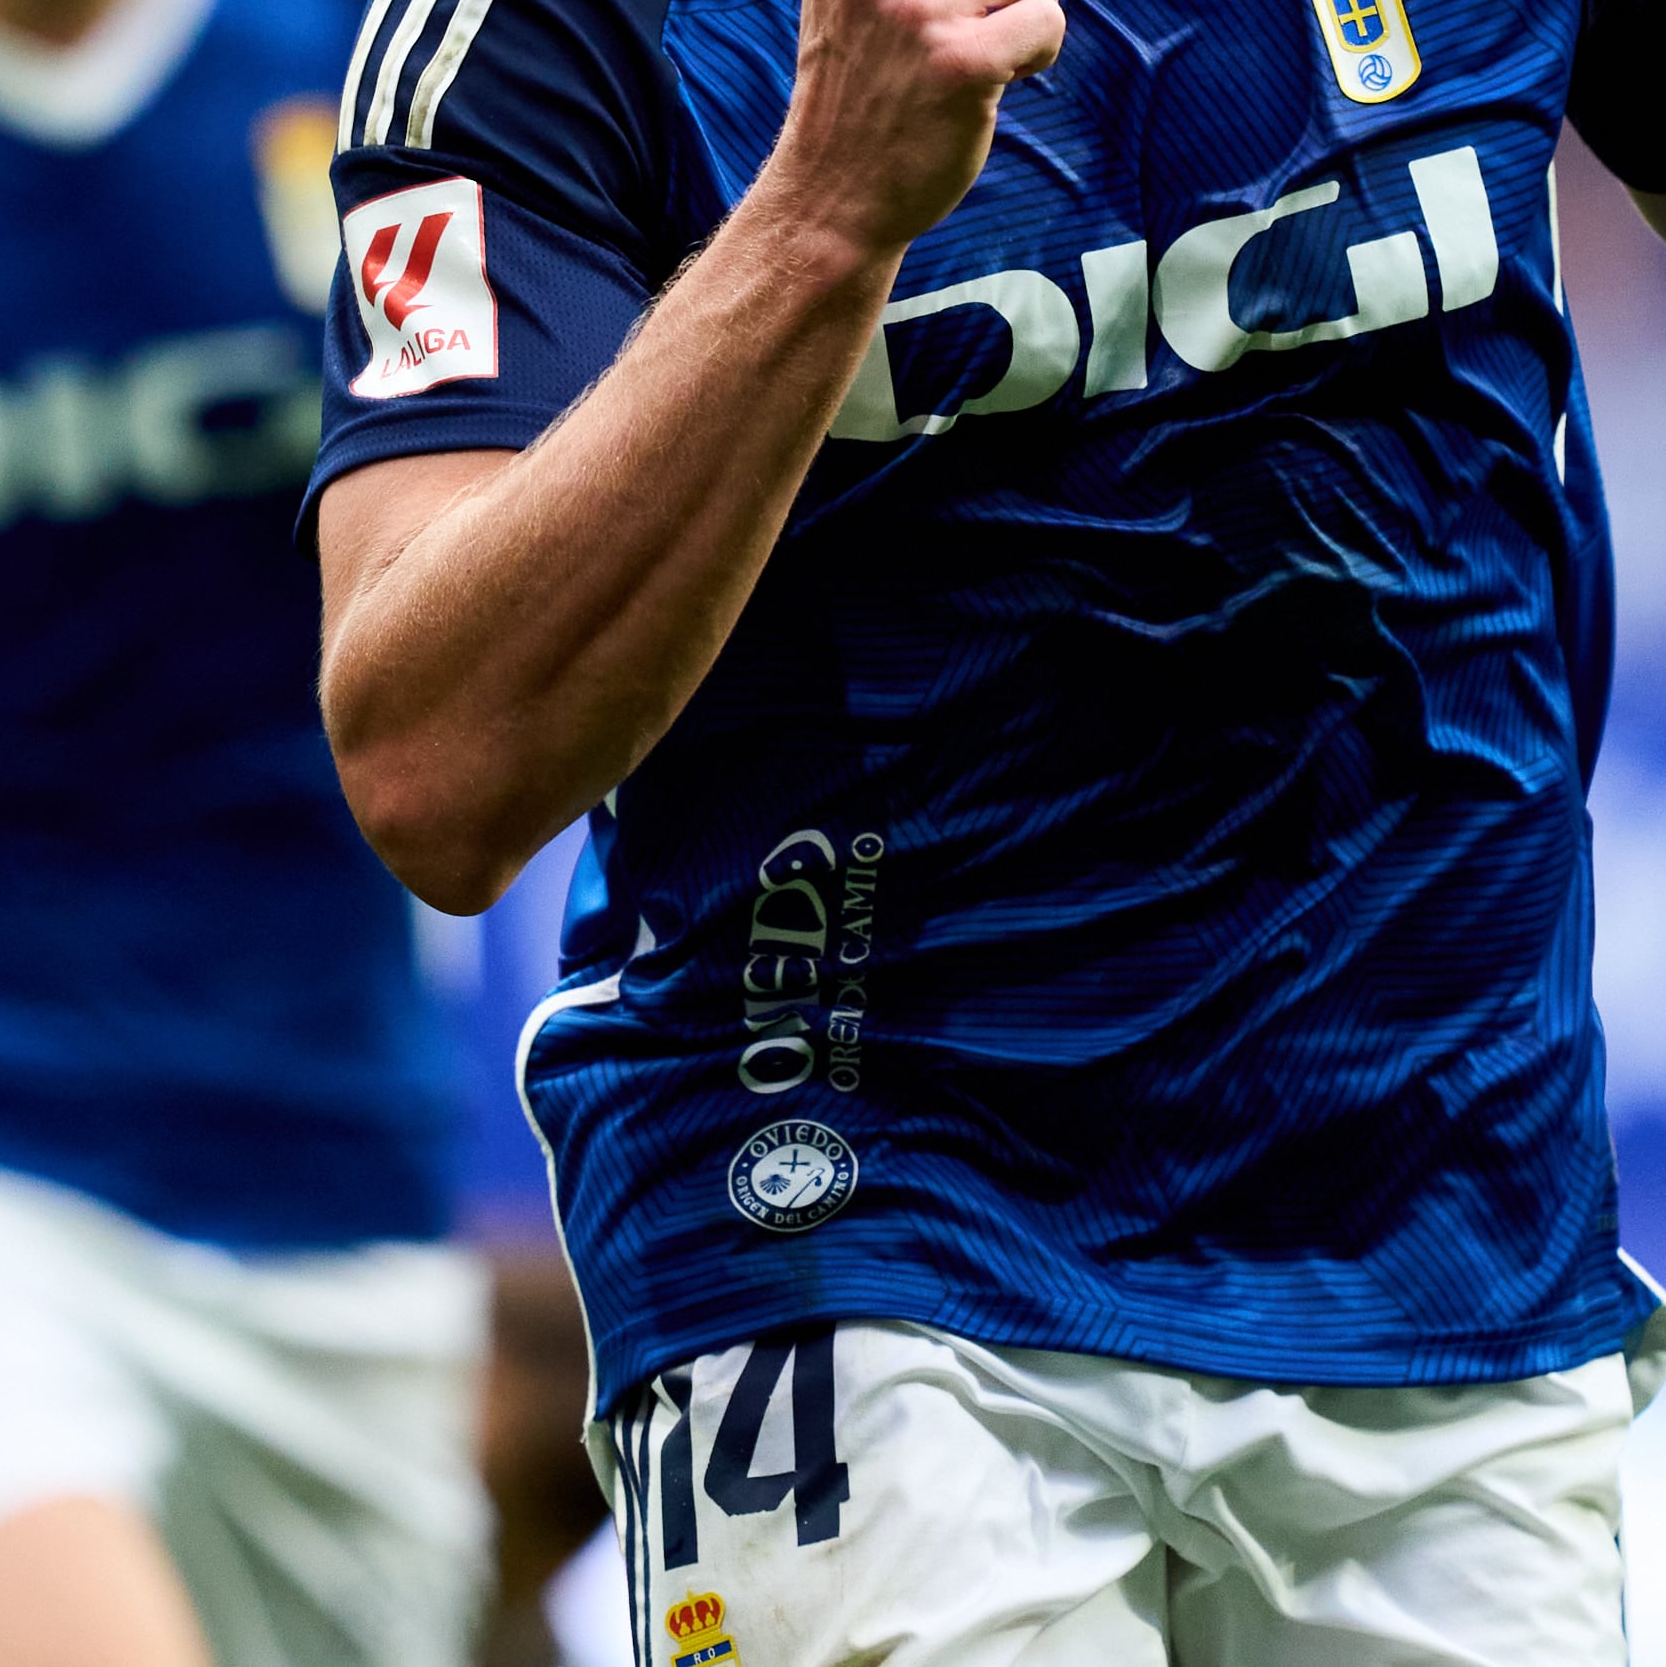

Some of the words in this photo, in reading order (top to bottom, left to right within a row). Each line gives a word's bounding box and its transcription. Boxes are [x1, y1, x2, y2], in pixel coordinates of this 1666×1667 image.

[829, 146, 1500, 441] DIGI
[380, 328, 472, 379] LALIGA
[749, 1124, 844, 1161] OVIEDO
[736, 1175, 770, 1220] ORIGEN
[774, 1212, 804, 1225] DEL
[807, 1171, 850, 1220] CAMINO
[657, 1333, 850, 1571] 14
